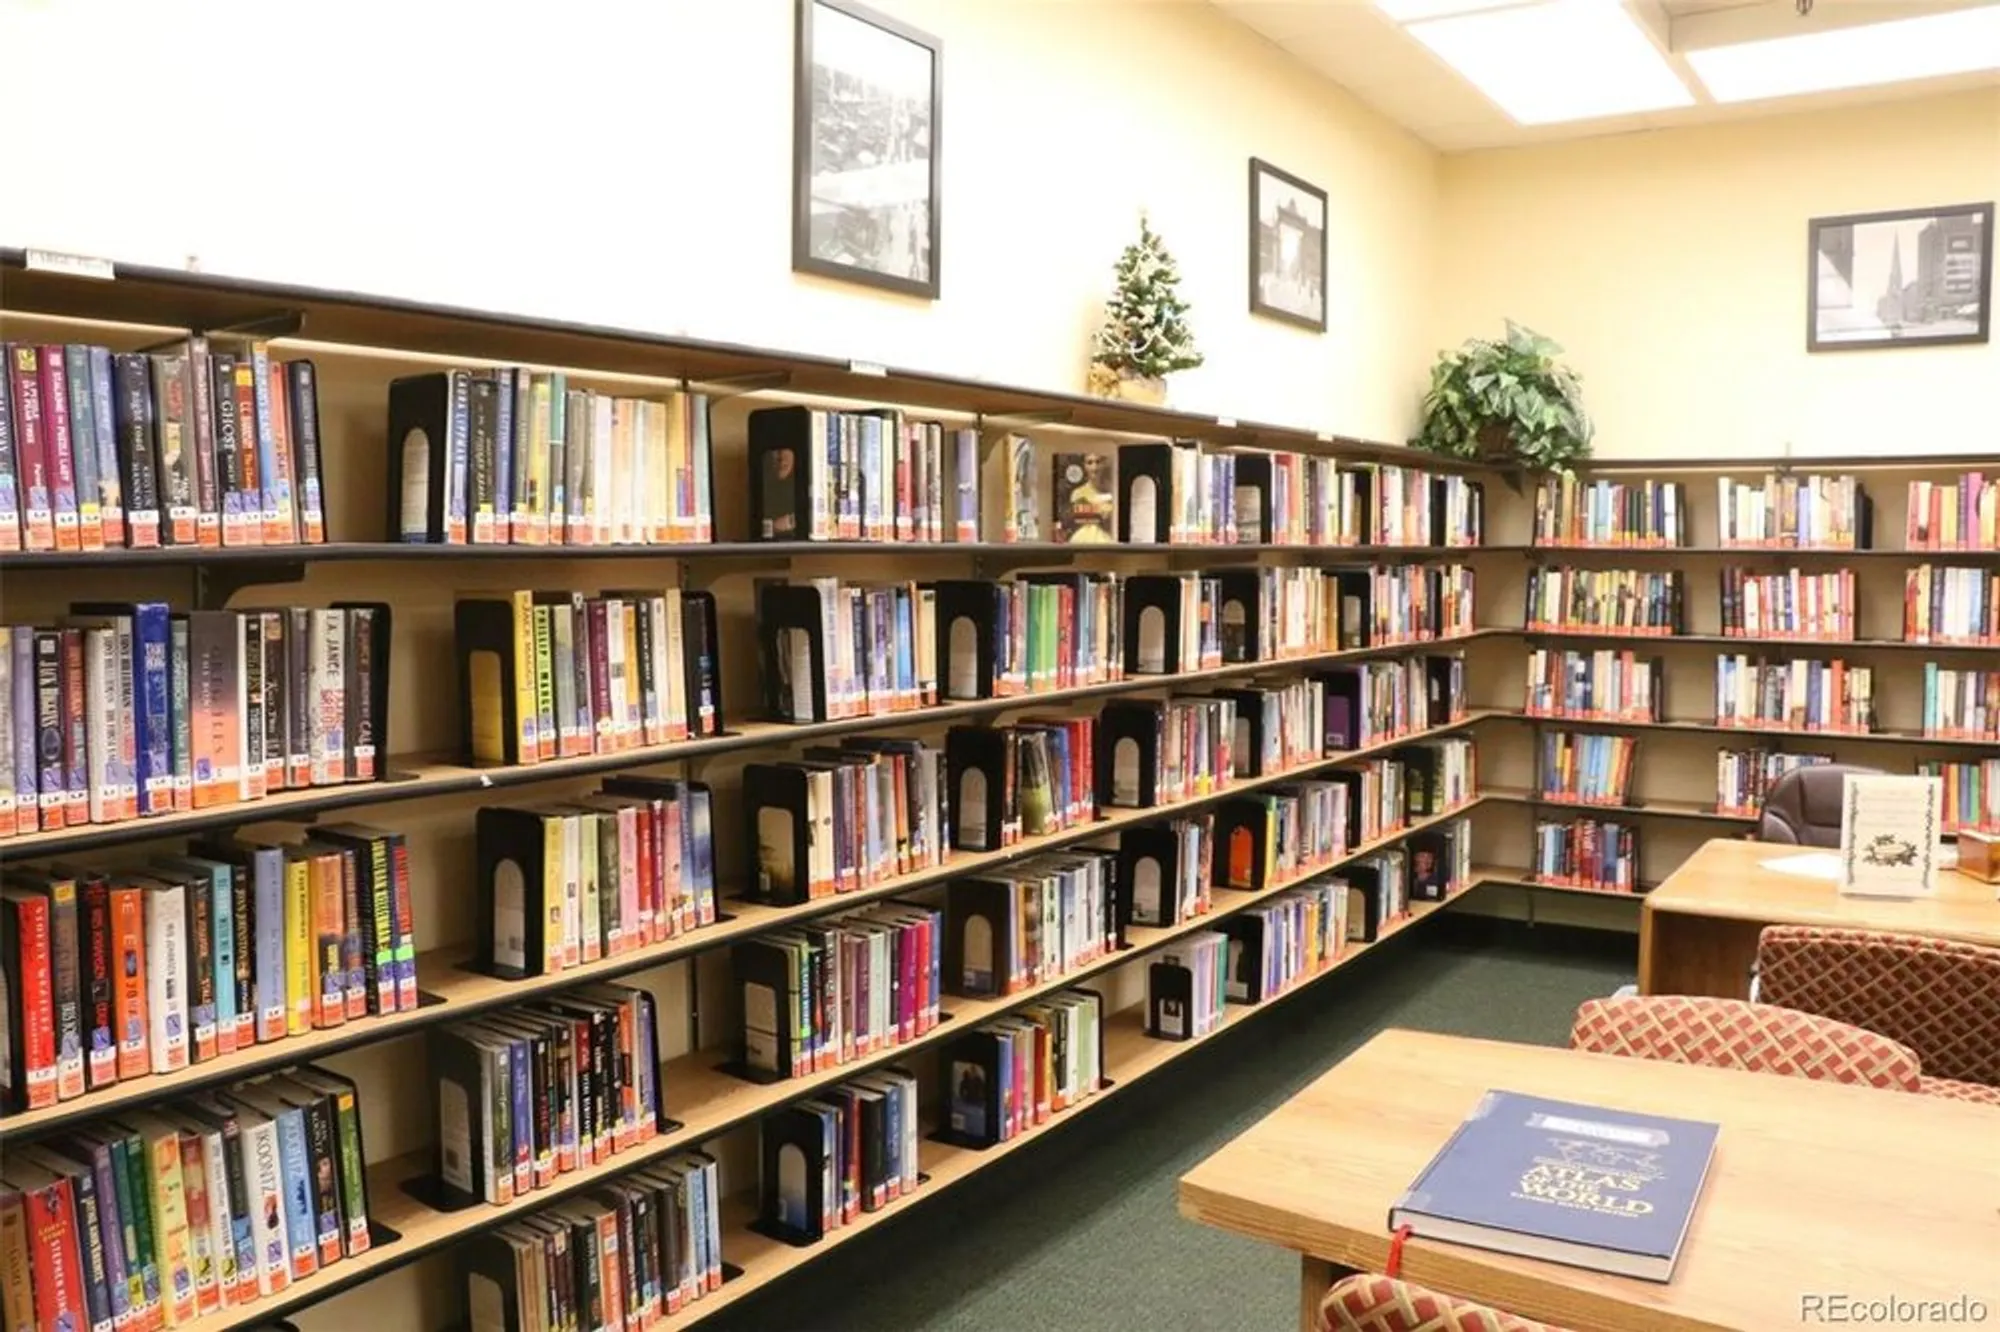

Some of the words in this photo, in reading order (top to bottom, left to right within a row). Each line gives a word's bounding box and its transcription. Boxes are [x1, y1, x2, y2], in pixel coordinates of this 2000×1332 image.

[455, 373, 467, 410] LAURA
[133, 424, 146, 452] road
[220, 400, 236, 451] GHOST
[454, 412, 466, 462] LIPPMAN
[537, 607, 548, 658] PHILLIP
[40, 659, 58, 686] JACK
[325, 637, 342, 678] JANCE
[120, 658, 131, 708] HILLERMAN
[41, 687, 60, 729] HIGGINS
[255, 1129, 277, 1196] KOONTZ
[1528, 1164, 1642, 1191] ATLAS
[1520, 1180, 1654, 1214] WORLD
[49, 1238, 66, 1288] STEPHEN
